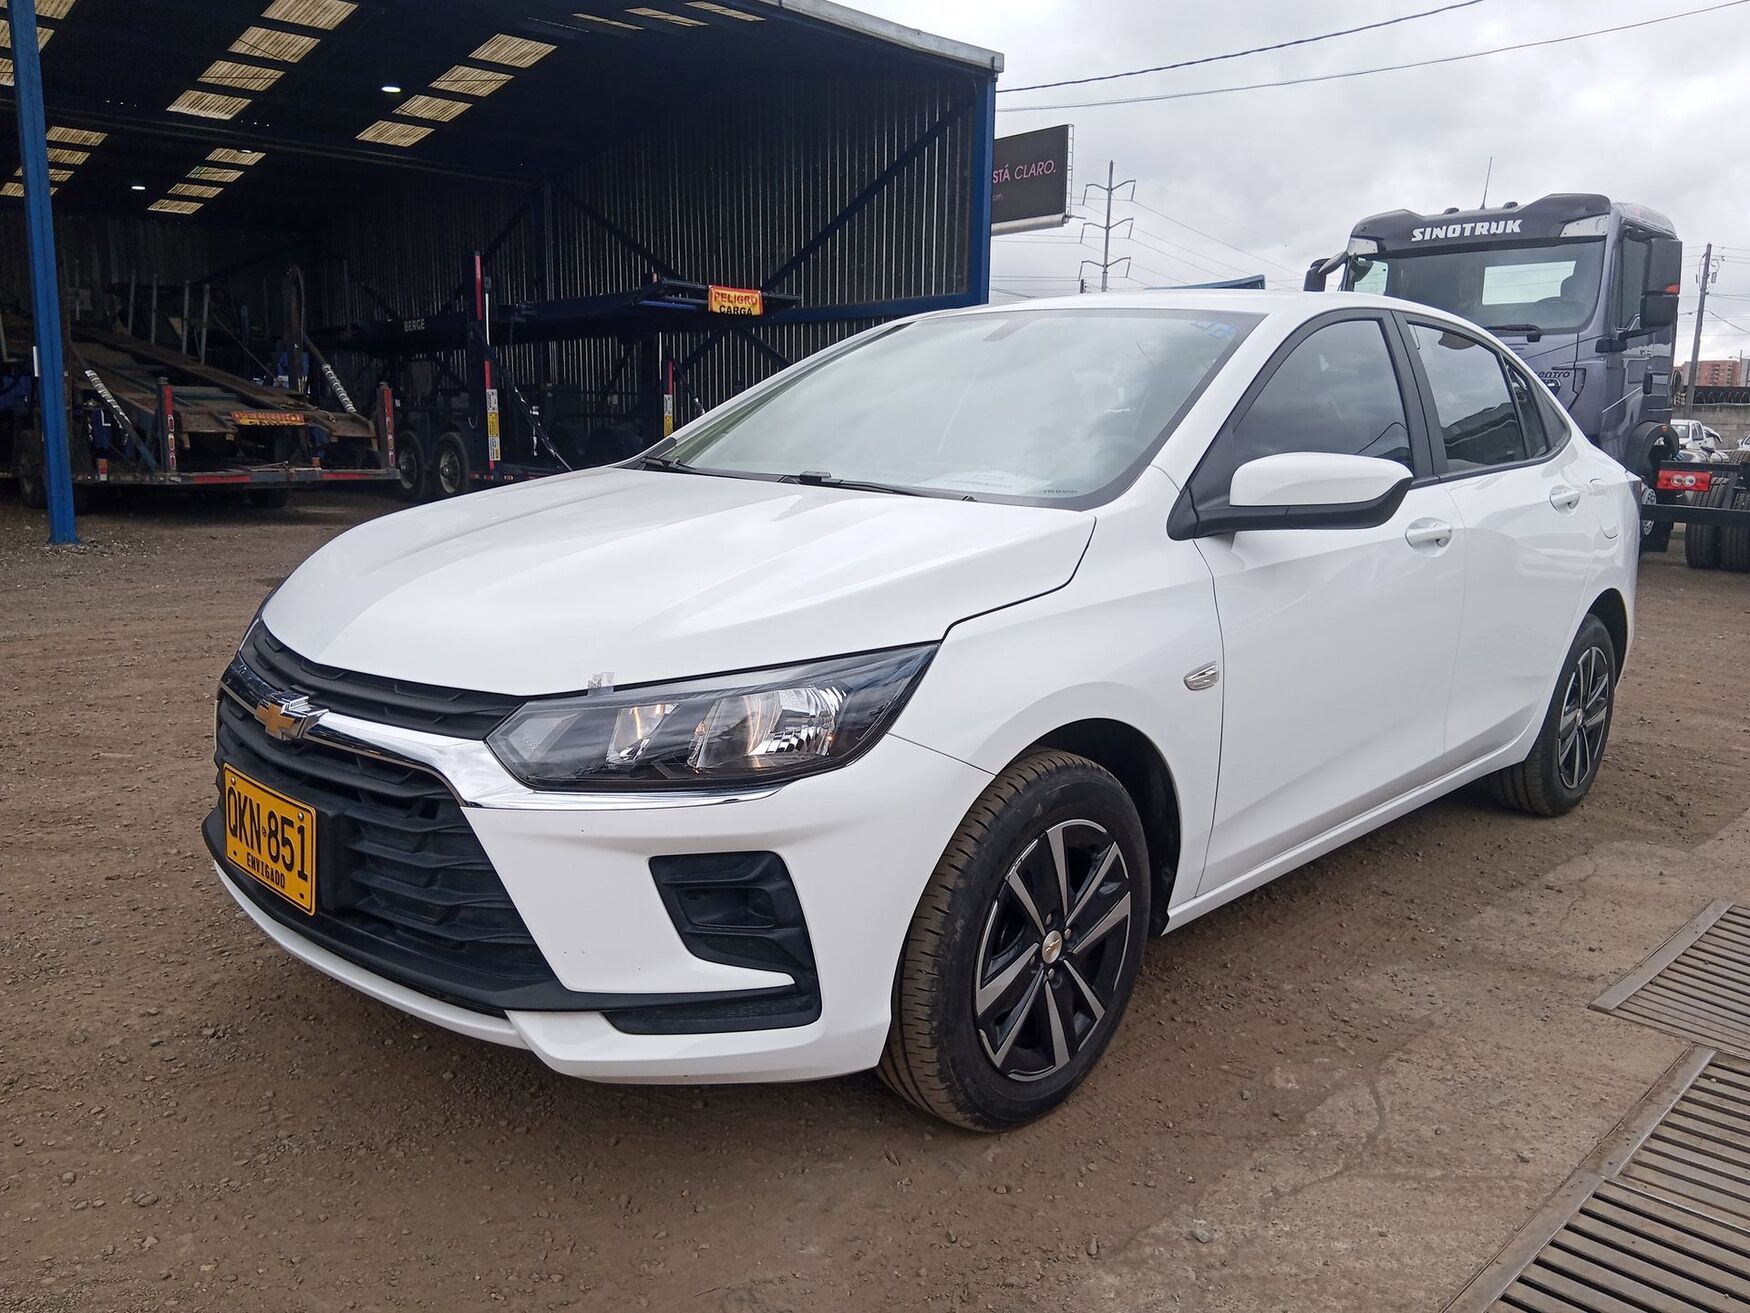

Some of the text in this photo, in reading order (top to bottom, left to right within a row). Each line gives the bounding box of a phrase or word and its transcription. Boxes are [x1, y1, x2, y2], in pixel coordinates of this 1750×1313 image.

[1014, 160, 1057, 180] CLARO.
[1411, 219, 1523, 242] SINOTRUK
[714, 291, 758, 306] PELIGRO
[719, 304, 753, 316] CARGA
[404, 318, 425, 332] BERGE
[1535, 370, 1571, 378] entro
[227, 786, 308, 882] QKN 851
[246, 851, 286, 889] ENVIGADO
